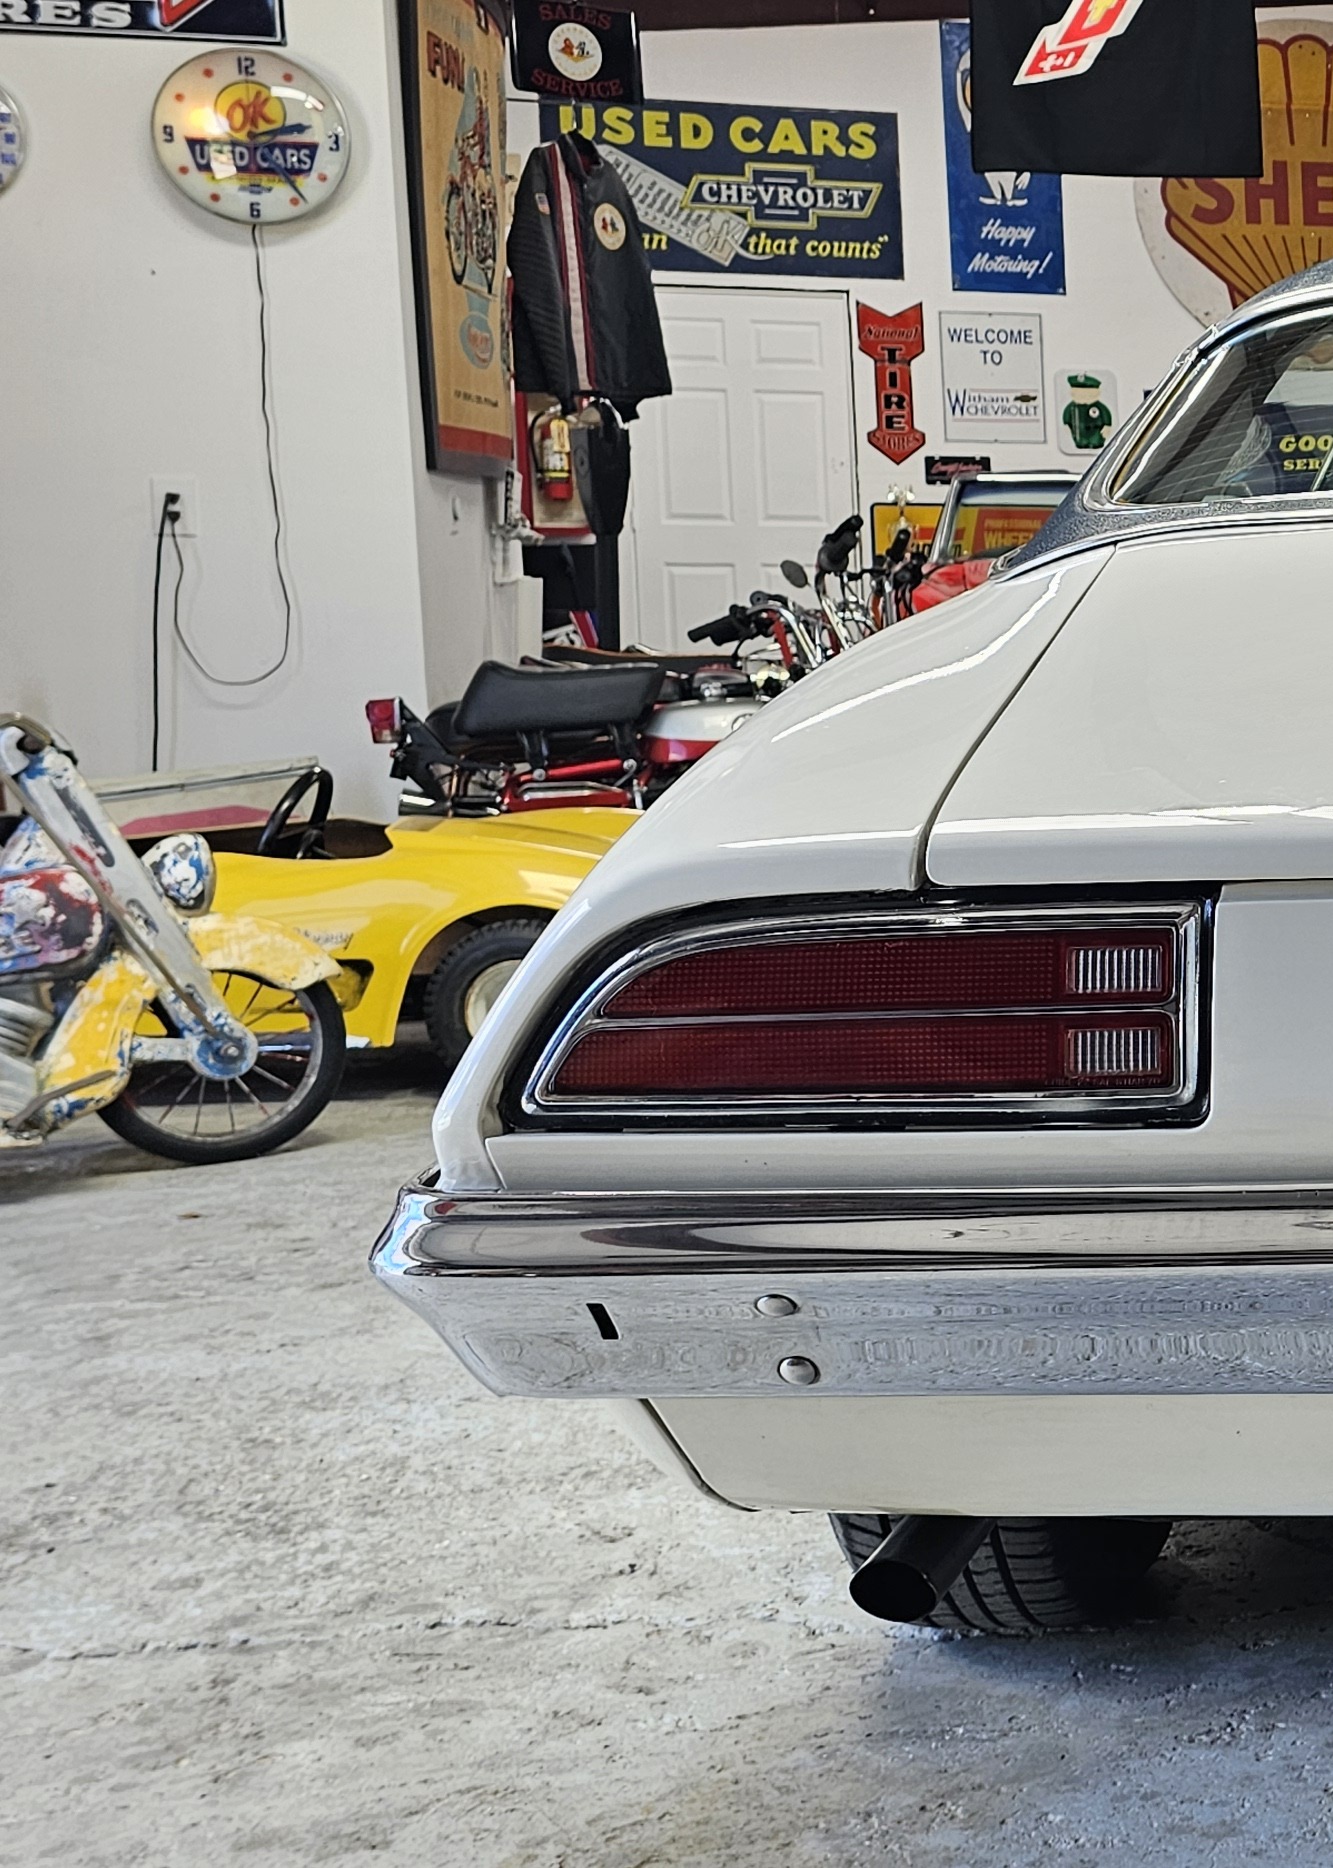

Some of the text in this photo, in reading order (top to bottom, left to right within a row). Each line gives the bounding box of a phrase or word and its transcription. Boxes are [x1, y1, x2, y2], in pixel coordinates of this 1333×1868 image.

[538, 3, 612, 30] SALES
[237, 56, 256, 76] 12
[531, 67, 623, 98] SERVICE
[226, 91, 277, 133] OK
[559, 104, 878, 160] USED CARS
[256, 147, 312, 170] CARS
[700, 181, 865, 210] CHEVROLET
[747, 231, 799, 257] that
[980, 218, 1035, 248] Happy
[967, 252, 1053, 279] Motoring!
[862, 324, 921, 342] National
[947, 326, 1034, 345] WELCOME
[979, 350, 1003, 366] TO
[877, 343, 910, 434] TIRE
[946, 388, 1011, 417] Witham
[966, 402, 1039, 418] CHEVROLET
[869, 430, 921, 451] STORES
